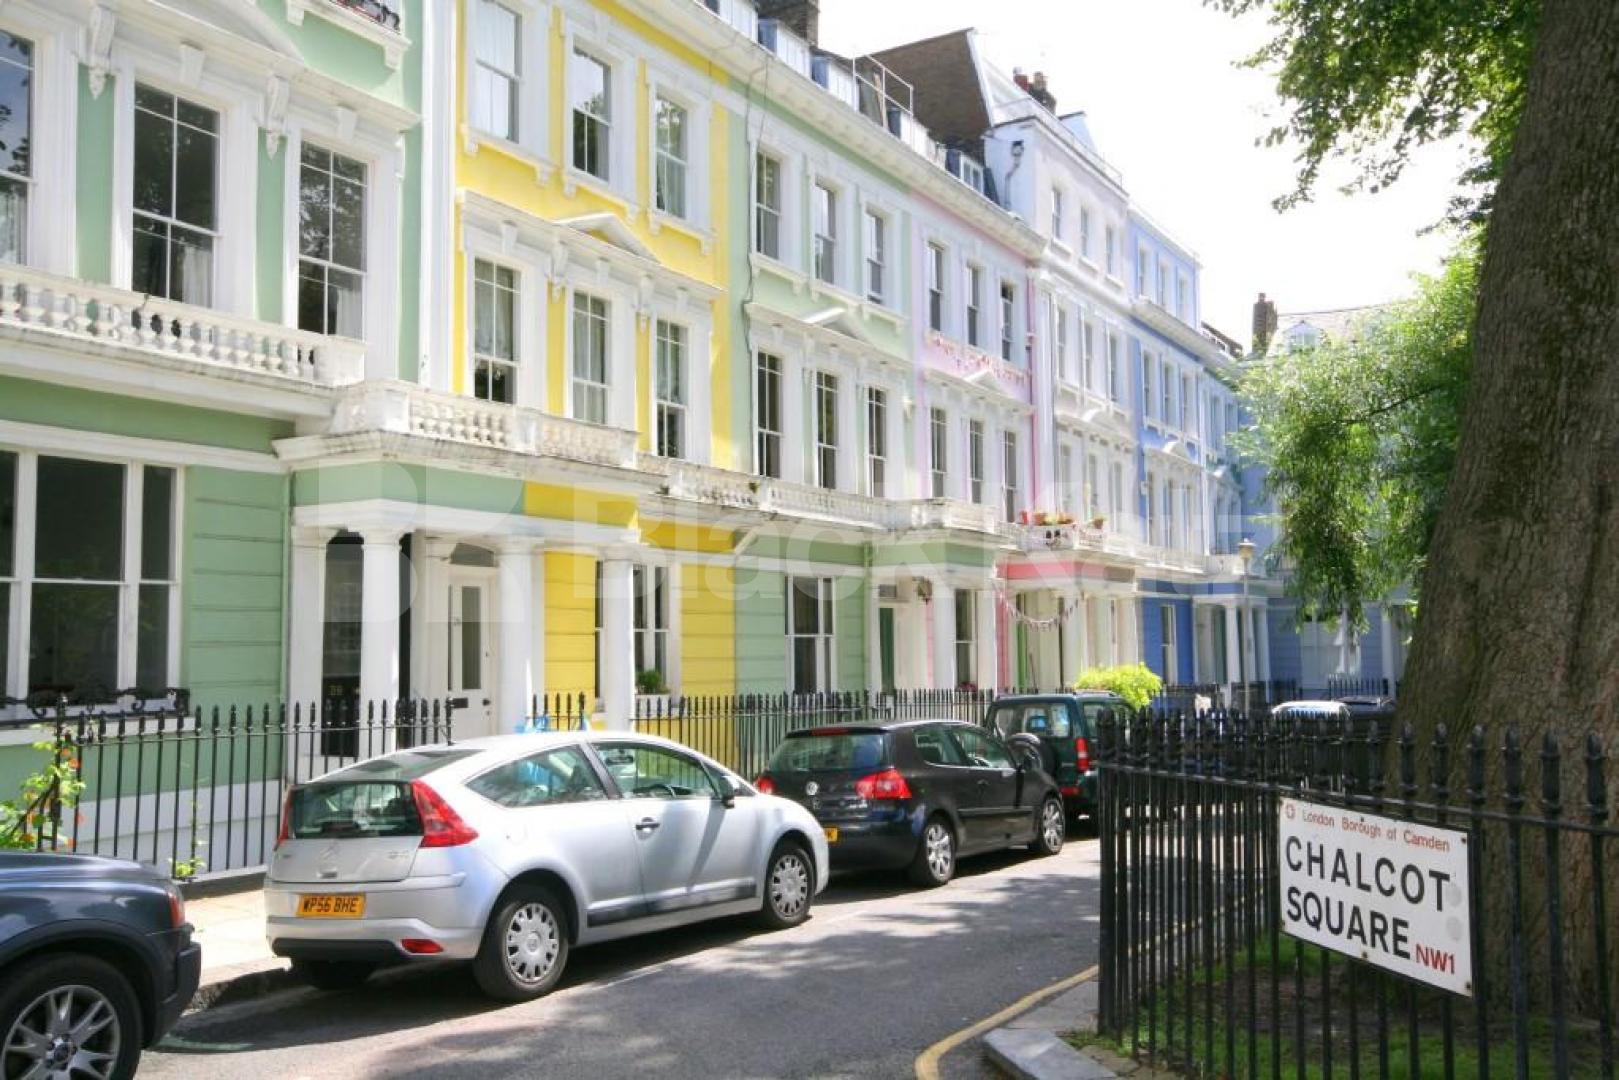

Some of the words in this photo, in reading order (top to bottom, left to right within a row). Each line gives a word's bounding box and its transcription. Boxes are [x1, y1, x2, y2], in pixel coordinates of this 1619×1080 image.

[1302, 807, 1335, 827] London
[1341, 816, 1382, 839] Borough
[1386, 828, 1397, 841] of
[1403, 829, 1450, 852] Camden
[1286, 836, 1451, 912] CHALCOT
[1287, 886, 1411, 960] SQUARE
[1416, 943, 1456, 975] NW1
